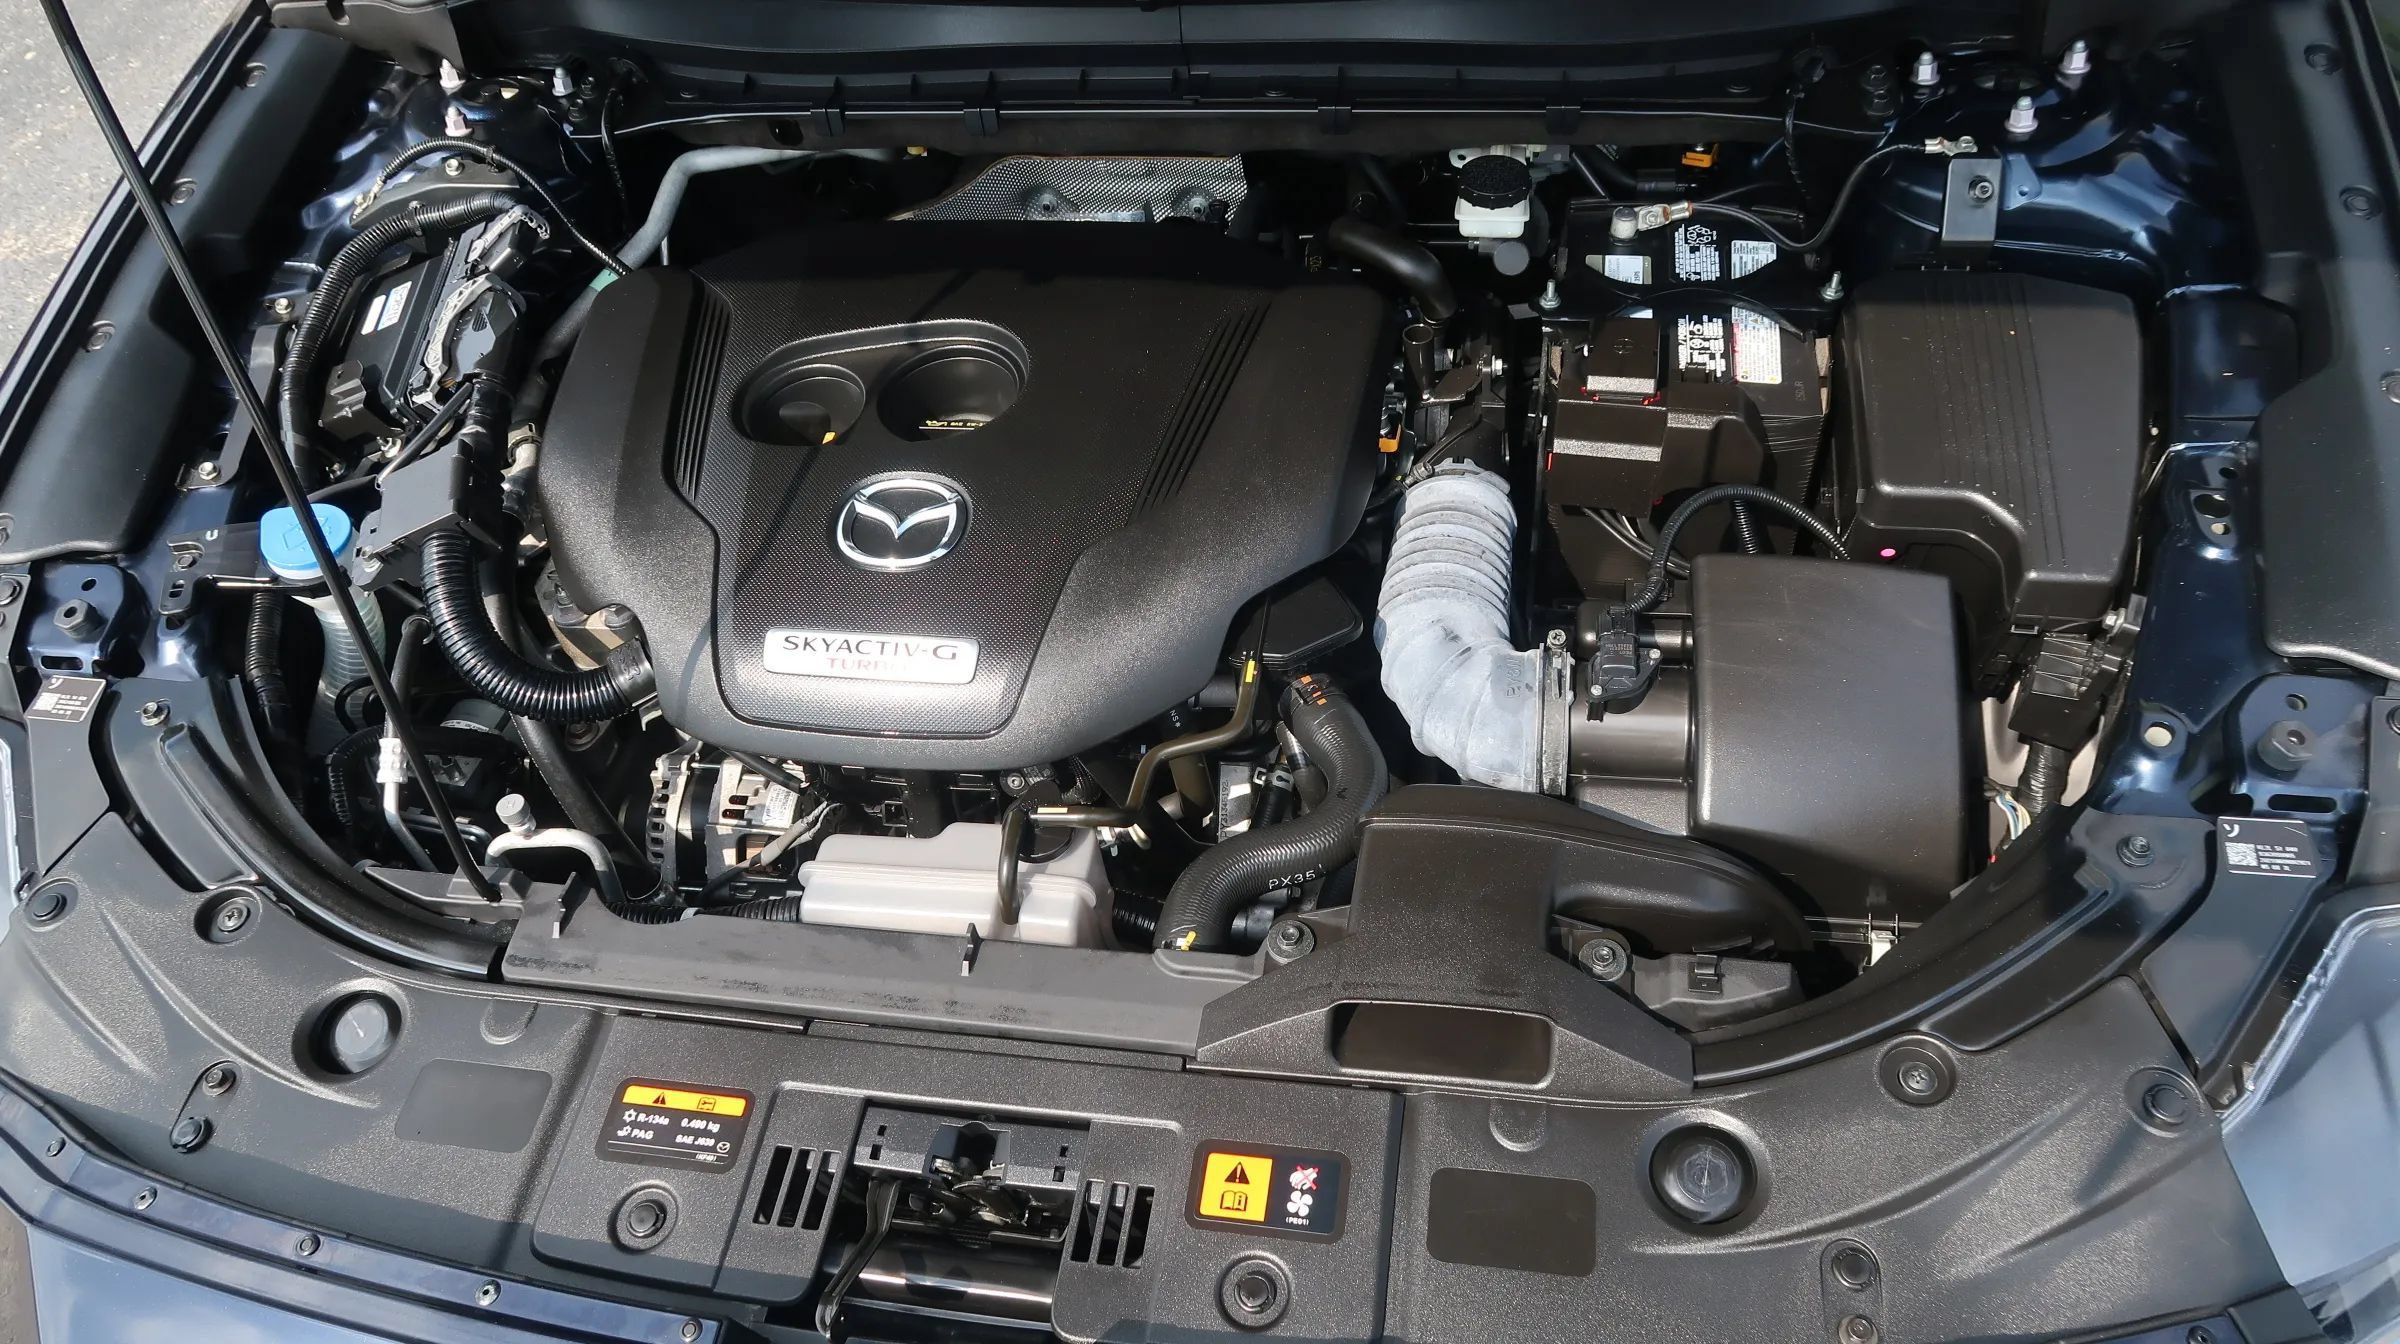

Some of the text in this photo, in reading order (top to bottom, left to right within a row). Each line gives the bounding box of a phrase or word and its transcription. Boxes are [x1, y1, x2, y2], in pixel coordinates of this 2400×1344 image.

[783, 635, 958, 660] SKYACTIV-G
[826, 657, 908, 673] TURB
[637, 1113, 669, 1125] R-134a
[707, 1121, 720, 1133] kg
[631, 1128, 654, 1139] PAG
[675, 1134, 693, 1145] SAE
